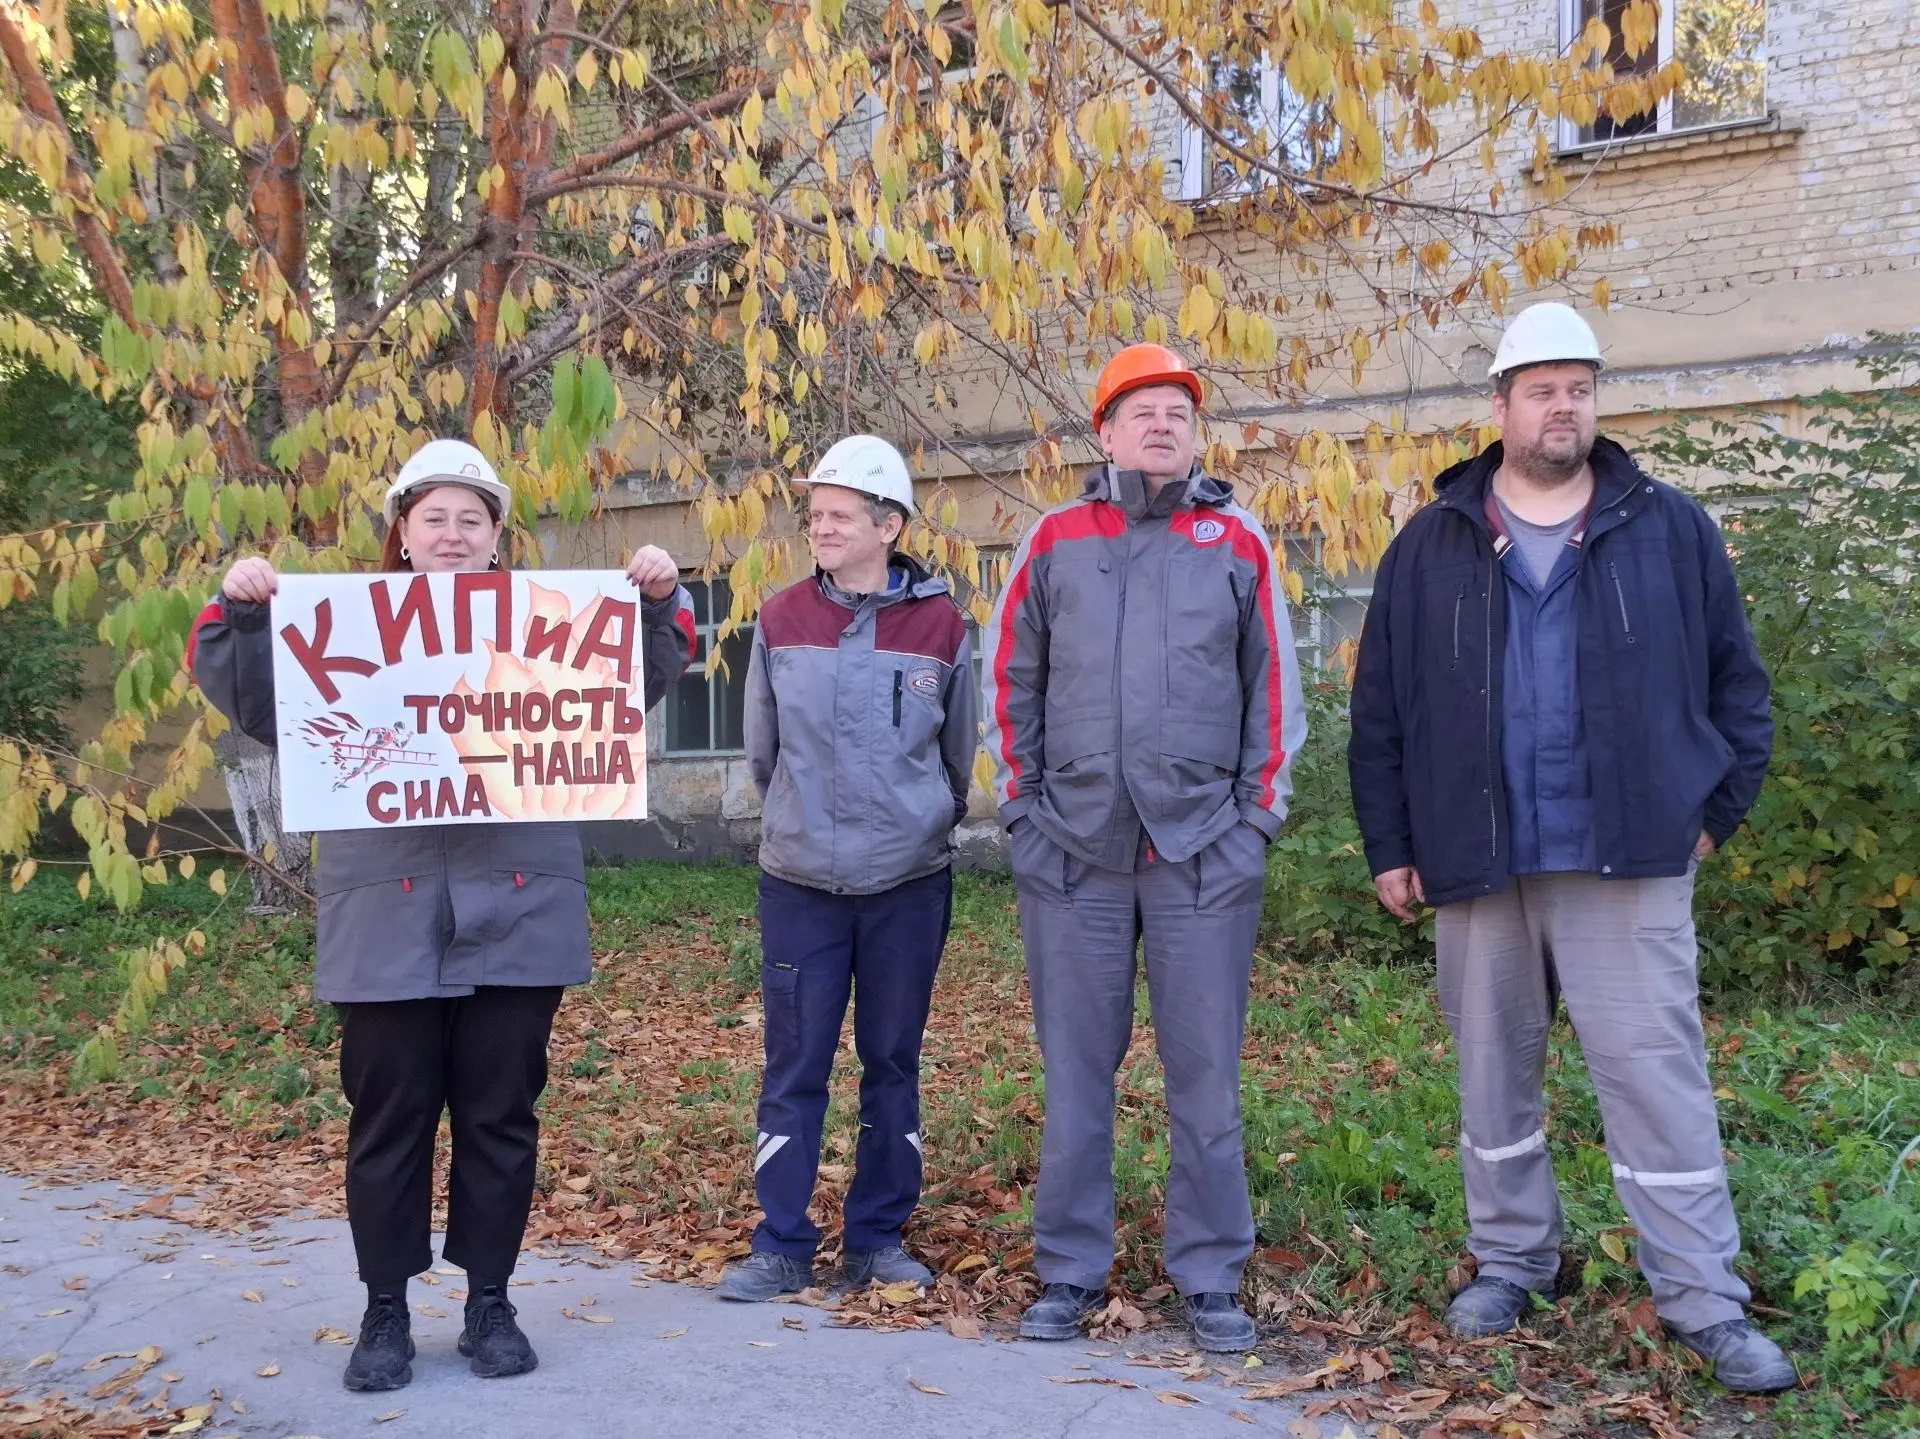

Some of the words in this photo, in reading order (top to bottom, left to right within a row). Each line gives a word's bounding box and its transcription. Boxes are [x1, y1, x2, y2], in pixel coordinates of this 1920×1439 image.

[280, 572, 636, 705] КИПиА
[404, 687, 643, 734] ТОЧНОСТЬ
[514, 740, 635, 787] НАША
[366, 774, 492, 824] СИЛА
